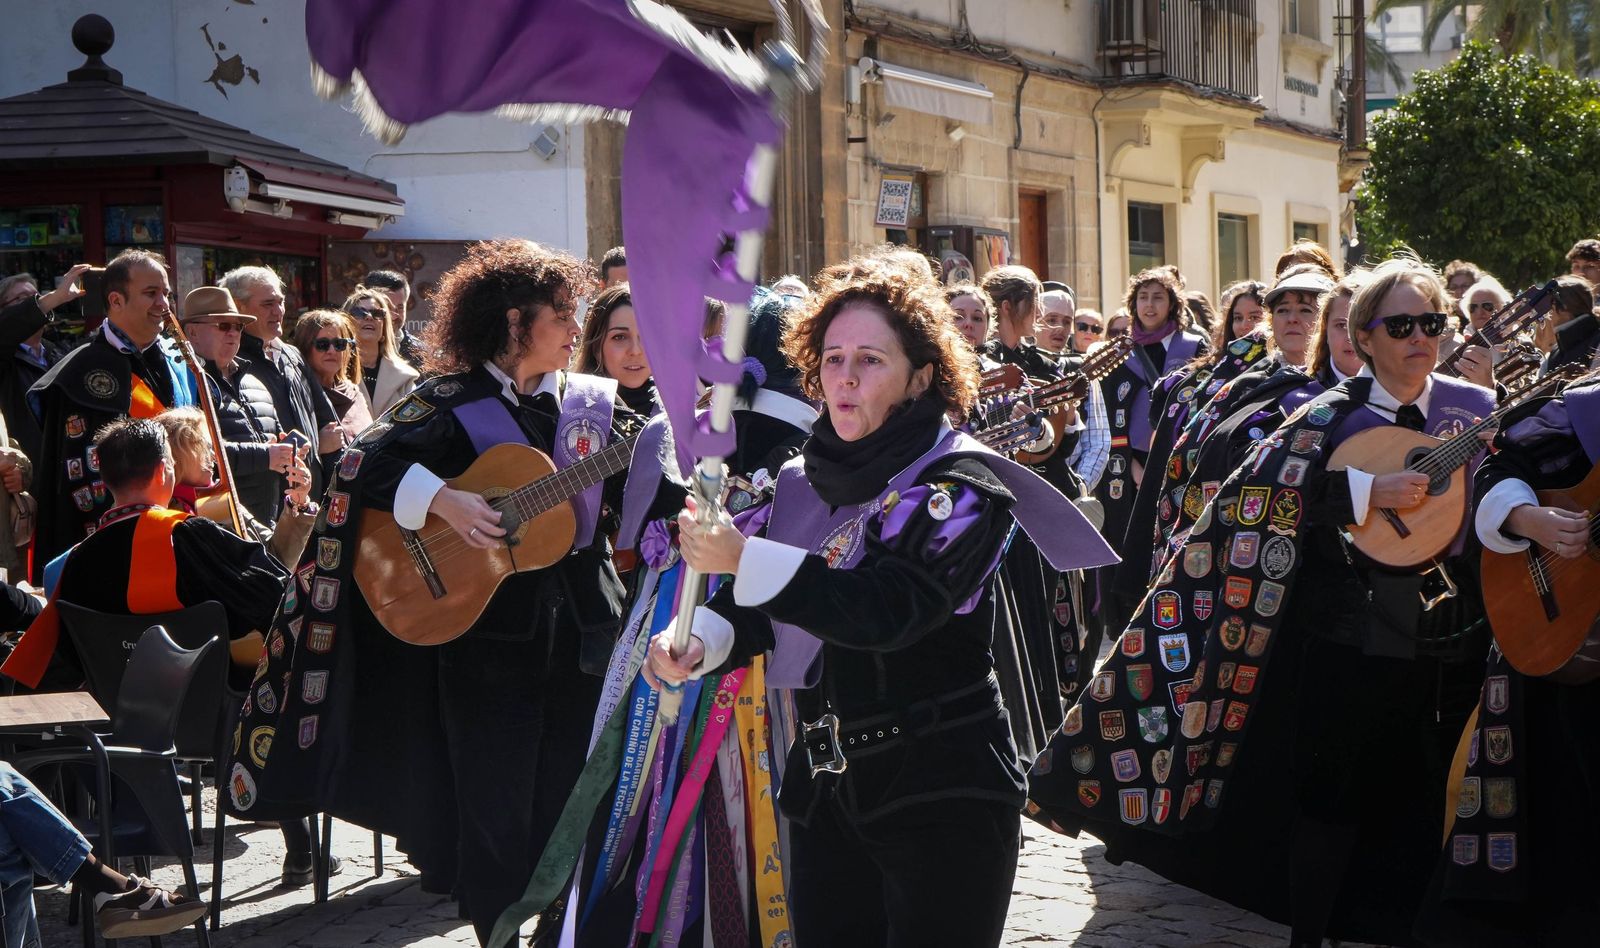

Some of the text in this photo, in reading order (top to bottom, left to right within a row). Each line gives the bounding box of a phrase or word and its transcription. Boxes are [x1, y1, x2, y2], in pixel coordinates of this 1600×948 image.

[634, 697, 645, 717] CON
[643, 710, 654, 737] ORBIS
[624, 756, 634, 768] DE
[631, 740, 648, 789] TERRARUM
[622, 770, 631, 782] LA
[624, 791, 635, 812] CUM
[603, 827, 617, 853] USMP
[605, 814, 628, 873] INSTRUMENTI
